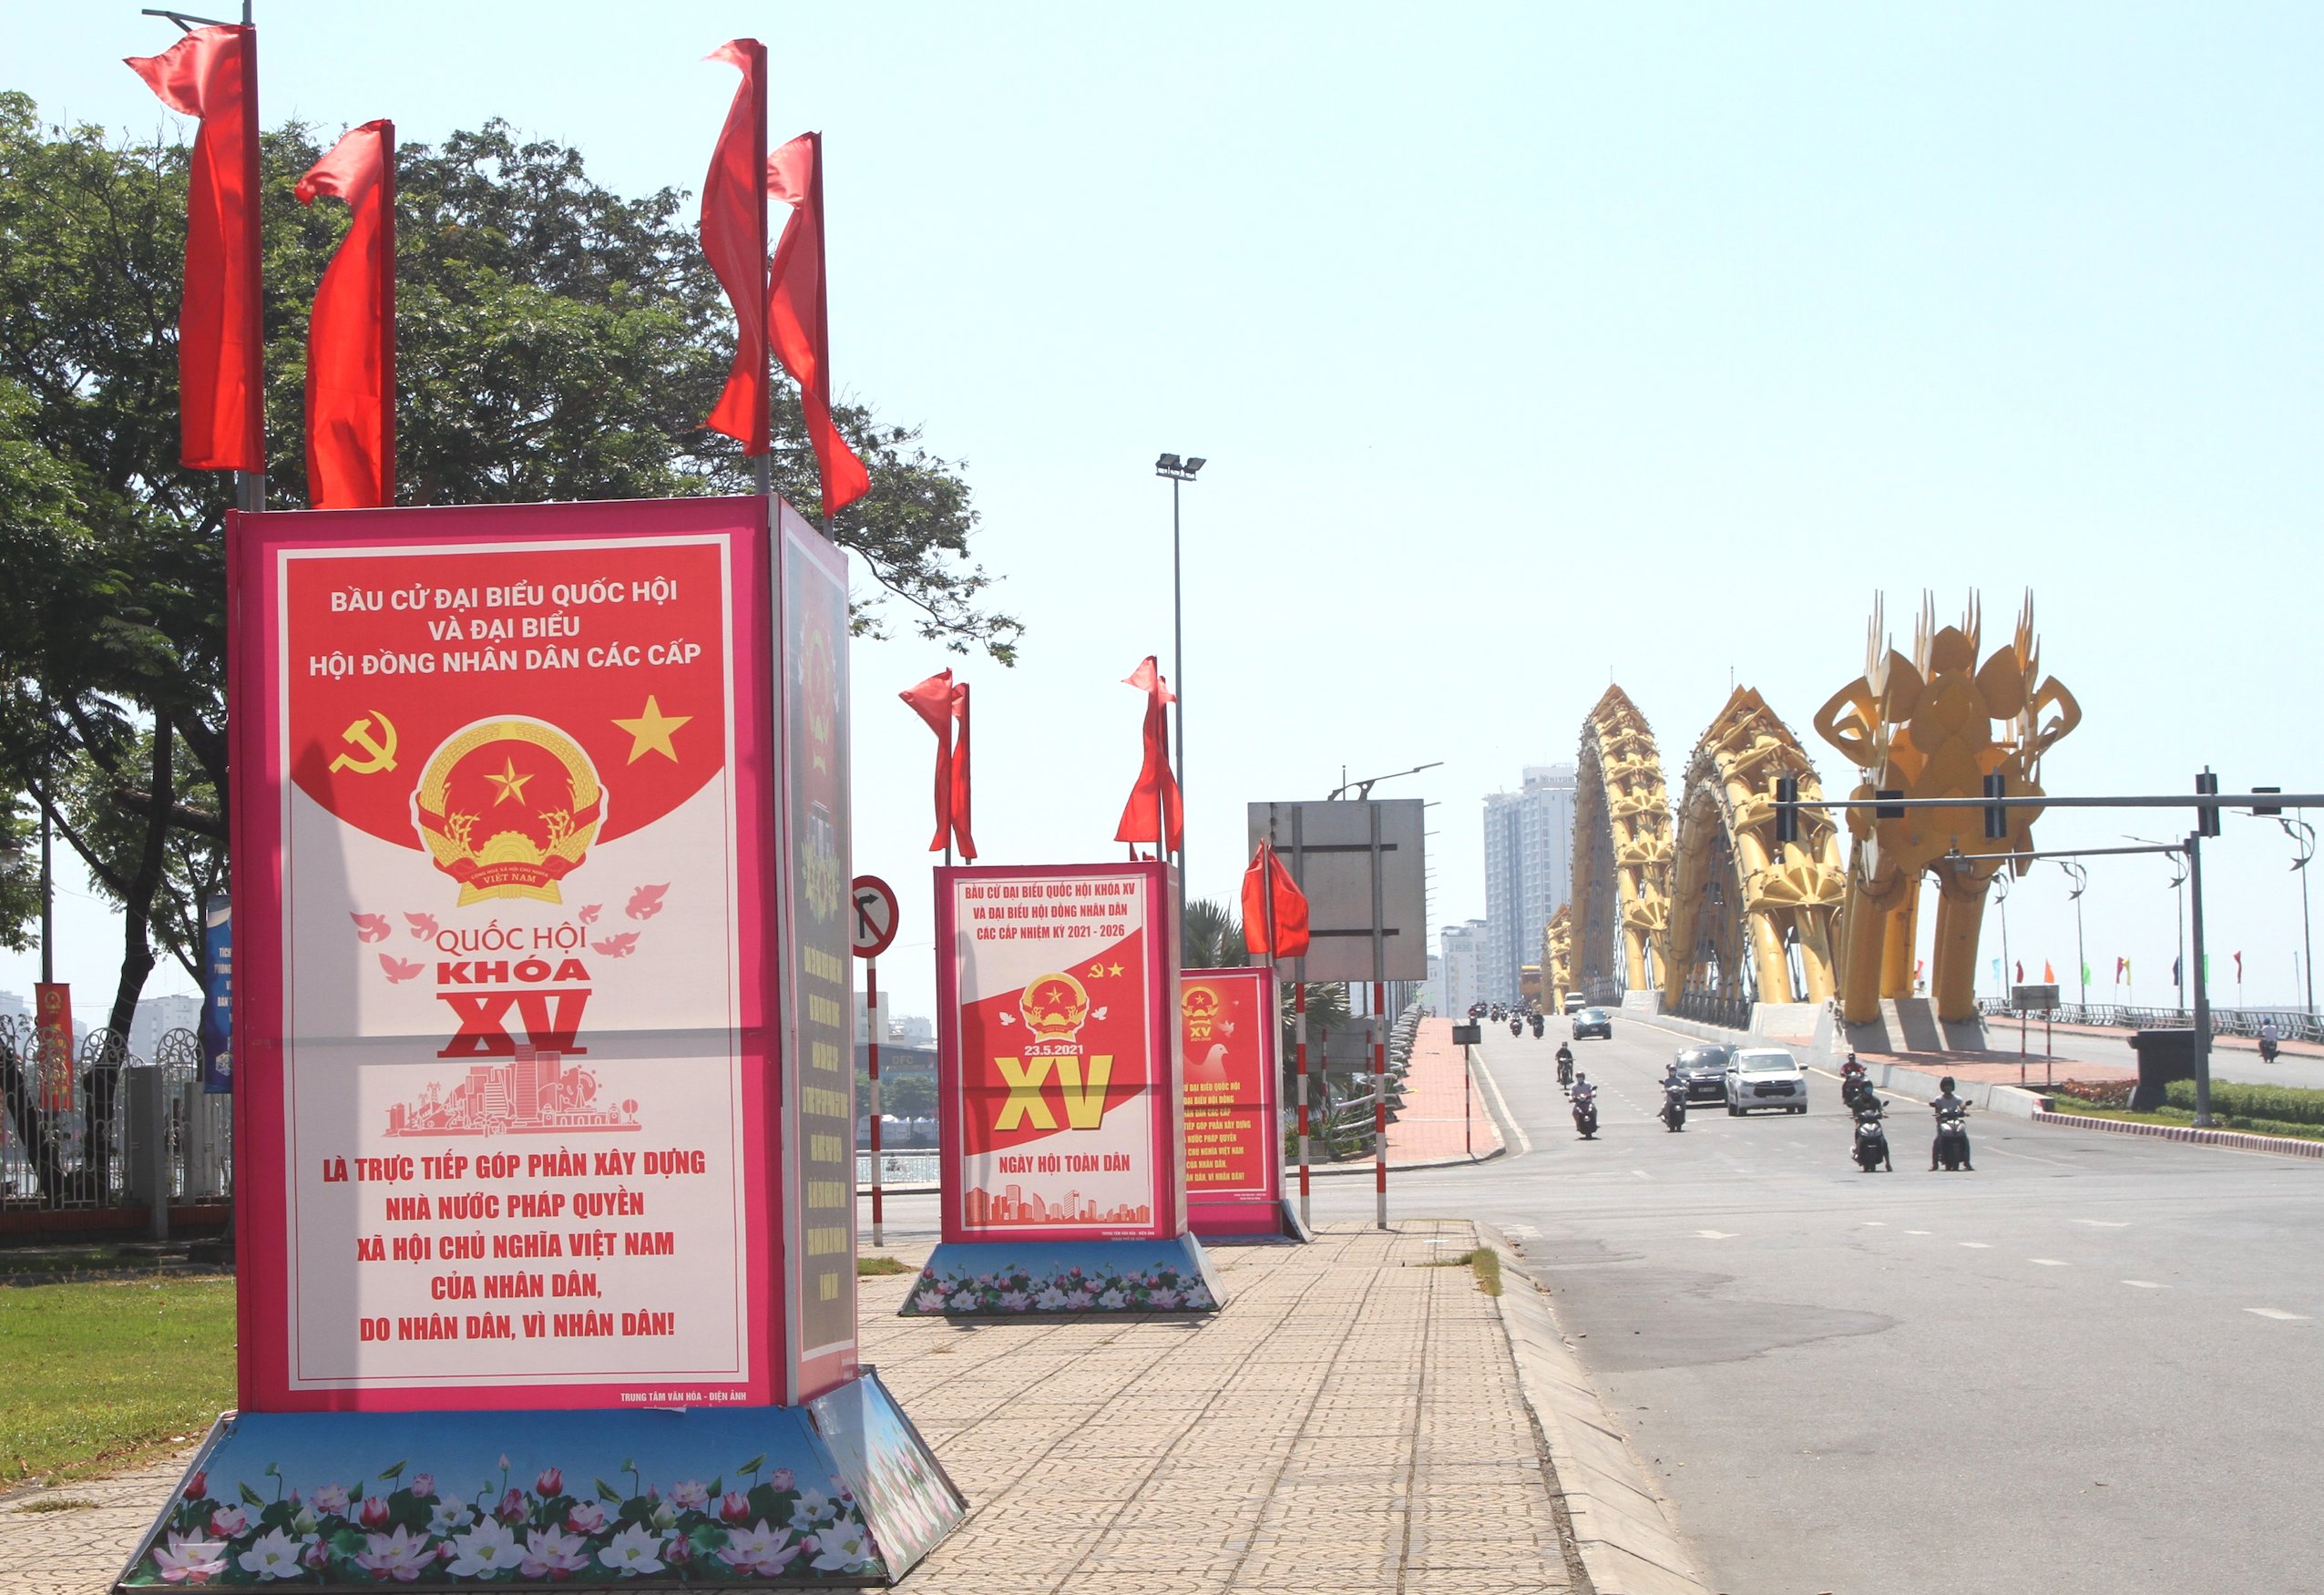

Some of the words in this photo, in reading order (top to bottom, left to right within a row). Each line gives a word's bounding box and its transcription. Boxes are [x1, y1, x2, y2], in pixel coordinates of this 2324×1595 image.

[330, 586, 384, 612] BẦU
[390, 582, 431, 611] CỬ
[434, 587, 479, 613] ĐẠI
[485, 578, 545, 608] BIỂU
[550, 577, 626, 608] QUỐC
[631, 575, 678, 606] HỘI
[427, 615, 465, 641] VÀ
[469, 618, 515, 644] ĐẠI
[521, 609, 581, 639] BIỂU
[309, 649, 355, 681] HỘI
[361, 649, 436, 675] ĐỒNG
[442, 641, 518, 673] NHÂN
[525, 642, 580, 670] DÂN
[586, 641, 641, 668] CÁC
[647, 638, 701, 666] CẤP
[484, 873, 509, 884] VIỆT
[511, 873, 537, 883] NAM
[965, 884, 984, 899] BẦU
[988, 885, 1000, 899] CỬ
[1003, 886, 1019, 900] ĐẠI
[1021, 882, 1043, 898] BIỂU
[1046, 881, 1071, 898] QUỐC
[1075, 884, 1091, 898] HỘI
[1094, 883, 1121, 896] KHÓA
[1123, 882, 1135, 895] XV
[973, 906, 986, 920] VÀ
[988, 906, 1004, 921] ĐẠI
[1007, 903, 1029, 919] BIỂU
[1031, 905, 1048, 920] HỘI
[1051, 902, 1077, 919] ĐỒNG
[1080, 903, 1105, 917] NHÂN
[1108, 903, 1128, 916] DÂN
[435, 918, 524, 956] QUỐC
[533, 919, 587, 954] HỘI
[977, 926, 996, 941] CÁC
[998, 924, 1018, 940] CẤP
[1020, 925, 1049, 941] NHIỆM
[1053, 924, 1064, 938] KỲ
[1068, 925, 1090, 938] 2021
[1101, 924, 1124, 937] 2026
[436, 956, 591, 986] KHÓA
[436, 988, 592, 1058] XV
[1190, 1027, 1212, 1038] XV
[1024, 1044, 1084, 1056] 23.5.2021
[994, 1055, 1114, 1130] XV
[323, 1155, 348, 1181] LÀ
[355, 1153, 415, 1185] TRỰC
[421, 1149, 469, 1181] TIẾP
[476, 1150, 521, 1179] GÓP
[527, 1146, 588, 1178] PHẦN
[594, 1148, 637, 1176] XÂY
[643, 1148, 706, 1179] DỰNG
[998, 1154, 1034, 1174] NGÀY
[1039, 1153, 1061, 1176] HỘI
[1064, 1152, 1100, 1172] TOÀN
[1103, 1151, 1131, 1172] DÂN
[385, 1193, 432, 1221] NHÀ
[438, 1191, 500, 1220] NƯỚC
[507, 1191, 566, 1218] PHÁP
[572, 1185, 645, 1219] QUYỀN
[357, 1234, 386, 1262] XÃ
[393, 1233, 432, 1264] HỘI
[438, 1231, 486, 1261] CHỦ
[493, 1231, 563, 1259] NGHĨA
[568, 1230, 618, 1261] VIỆT
[624, 1231, 675, 1256] NAM
[431, 1271, 477, 1301] CỦA
[484, 1271, 544, 1298] NHÂN
[551, 1270, 601, 1297] DÂN,
[360, 1316, 391, 1342] DO
[397, 1312, 458, 1340] NHÂN
[466, 1312, 517, 1339] DÂN,
[522, 1312, 546, 1338] VÌ
[553, 1311, 614, 1337] NHÂN
[621, 1308, 675, 1336] DÂN!
[620, 1392, 647, 1402] TRUNG
[649, 1391, 666, 1401] TÂM
[668, 1391, 684, 1401] VĂN
[686, 1390, 701, 1400] HÓA
[709, 1390, 728, 1403] ĐIỆN
[729, 1389, 747, 1401] ẢNH
